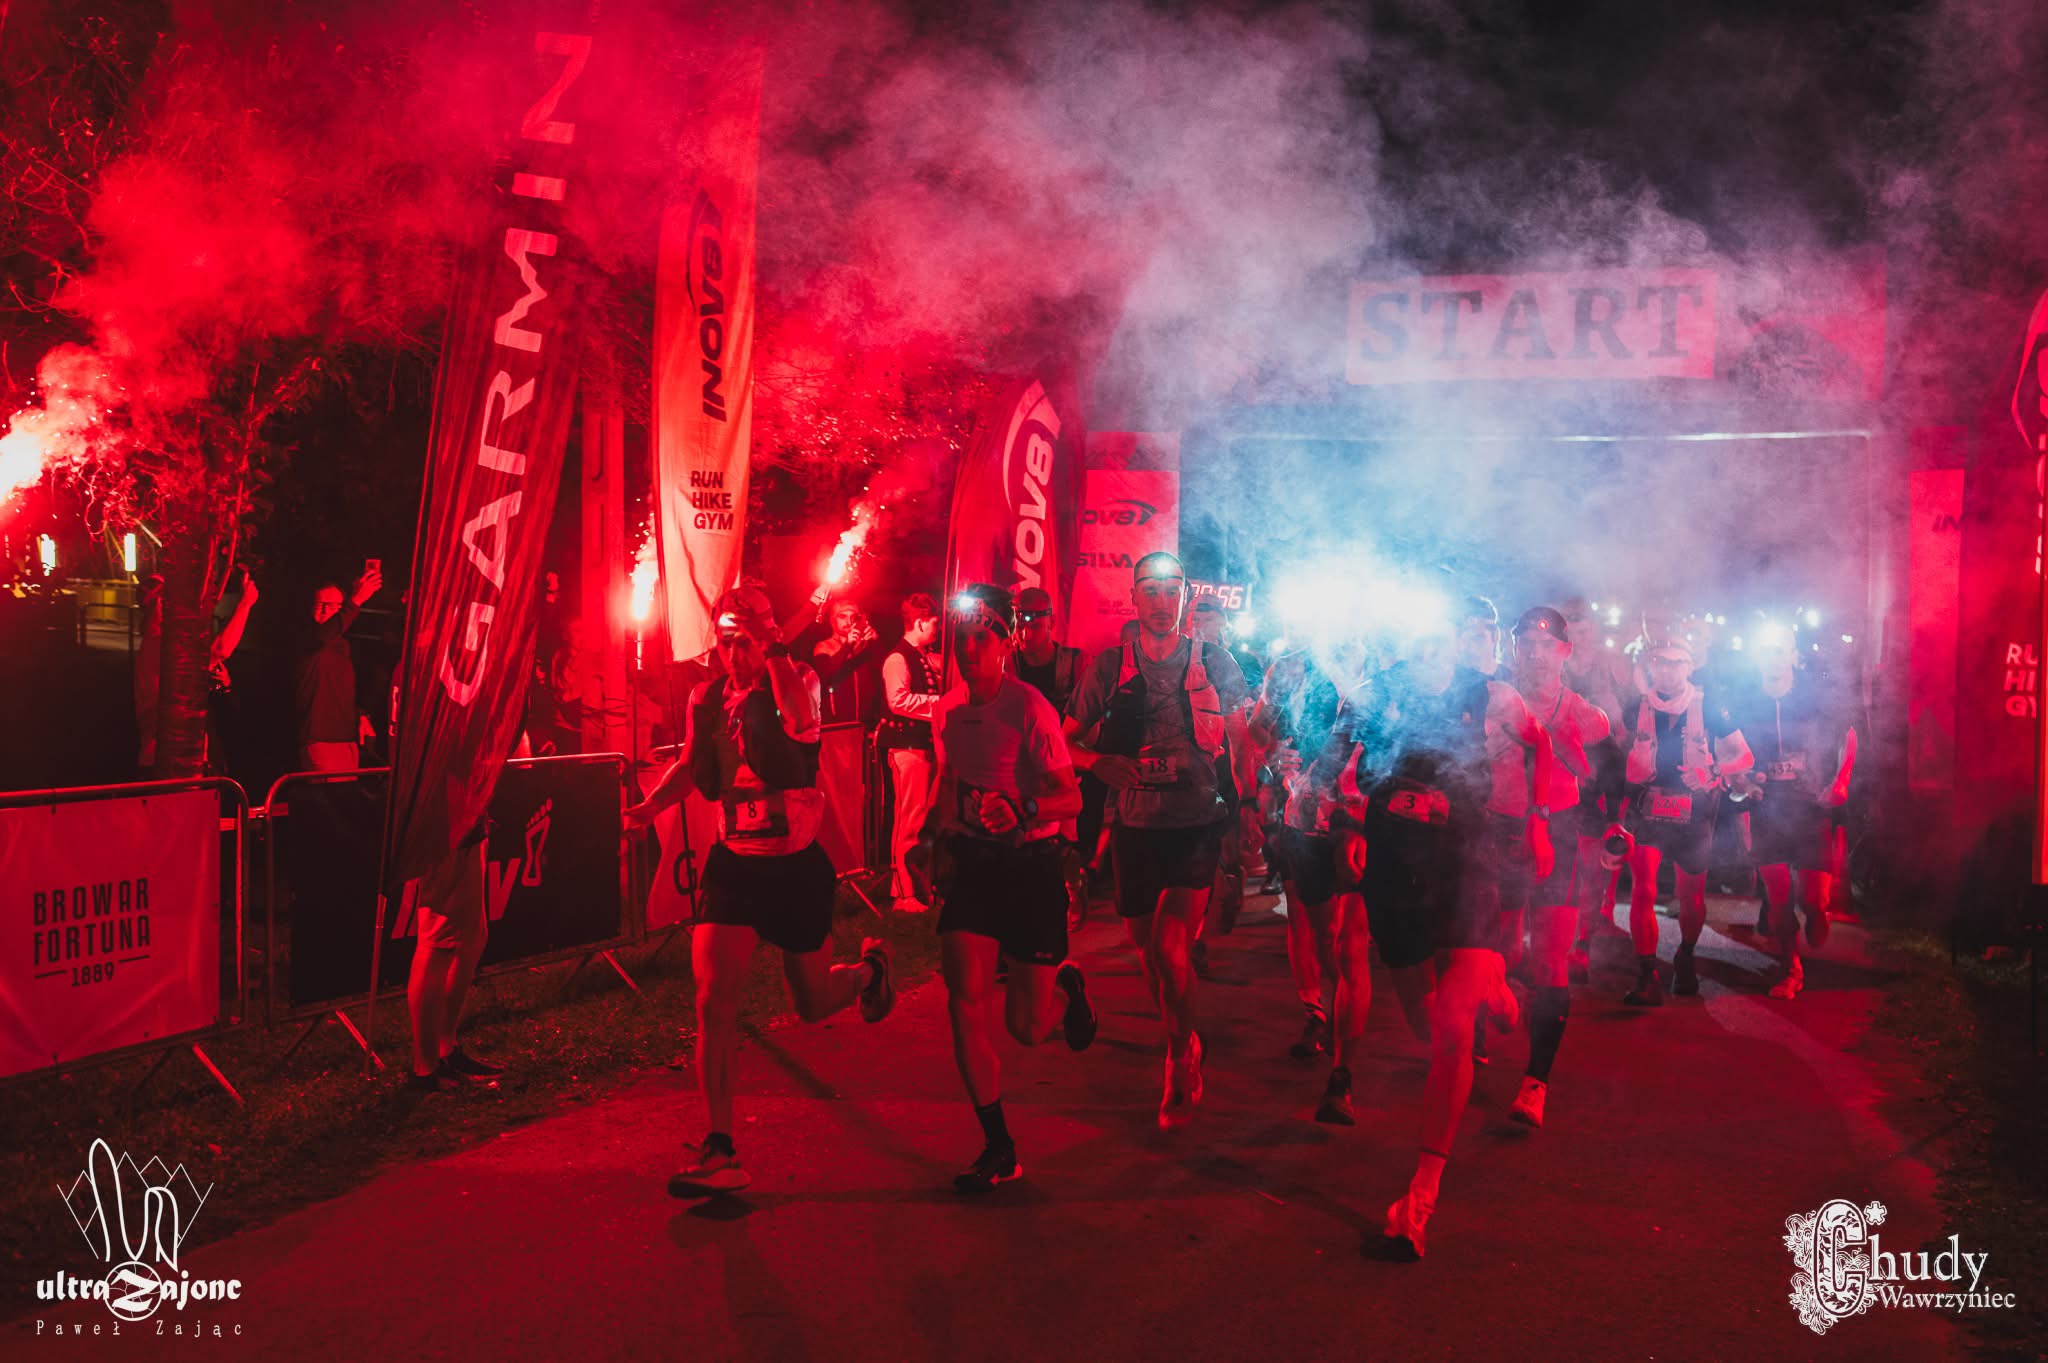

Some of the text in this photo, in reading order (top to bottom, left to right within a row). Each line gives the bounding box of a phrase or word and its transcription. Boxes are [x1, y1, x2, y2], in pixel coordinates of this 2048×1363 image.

[699, 235, 728, 424] INOV8
[1360, 284, 1702, 364] START
[440, 30, 592, 706] GARMIN
[690, 470, 724, 489] RUN
[691, 491, 733, 510] HIKE
[693, 512, 735, 531] GYM
[747, 800, 758, 819] 8
[33, 877, 149, 927] BROWAR
[33, 915, 151, 967] FORTUNA
[71, 961, 115, 988] 1889
